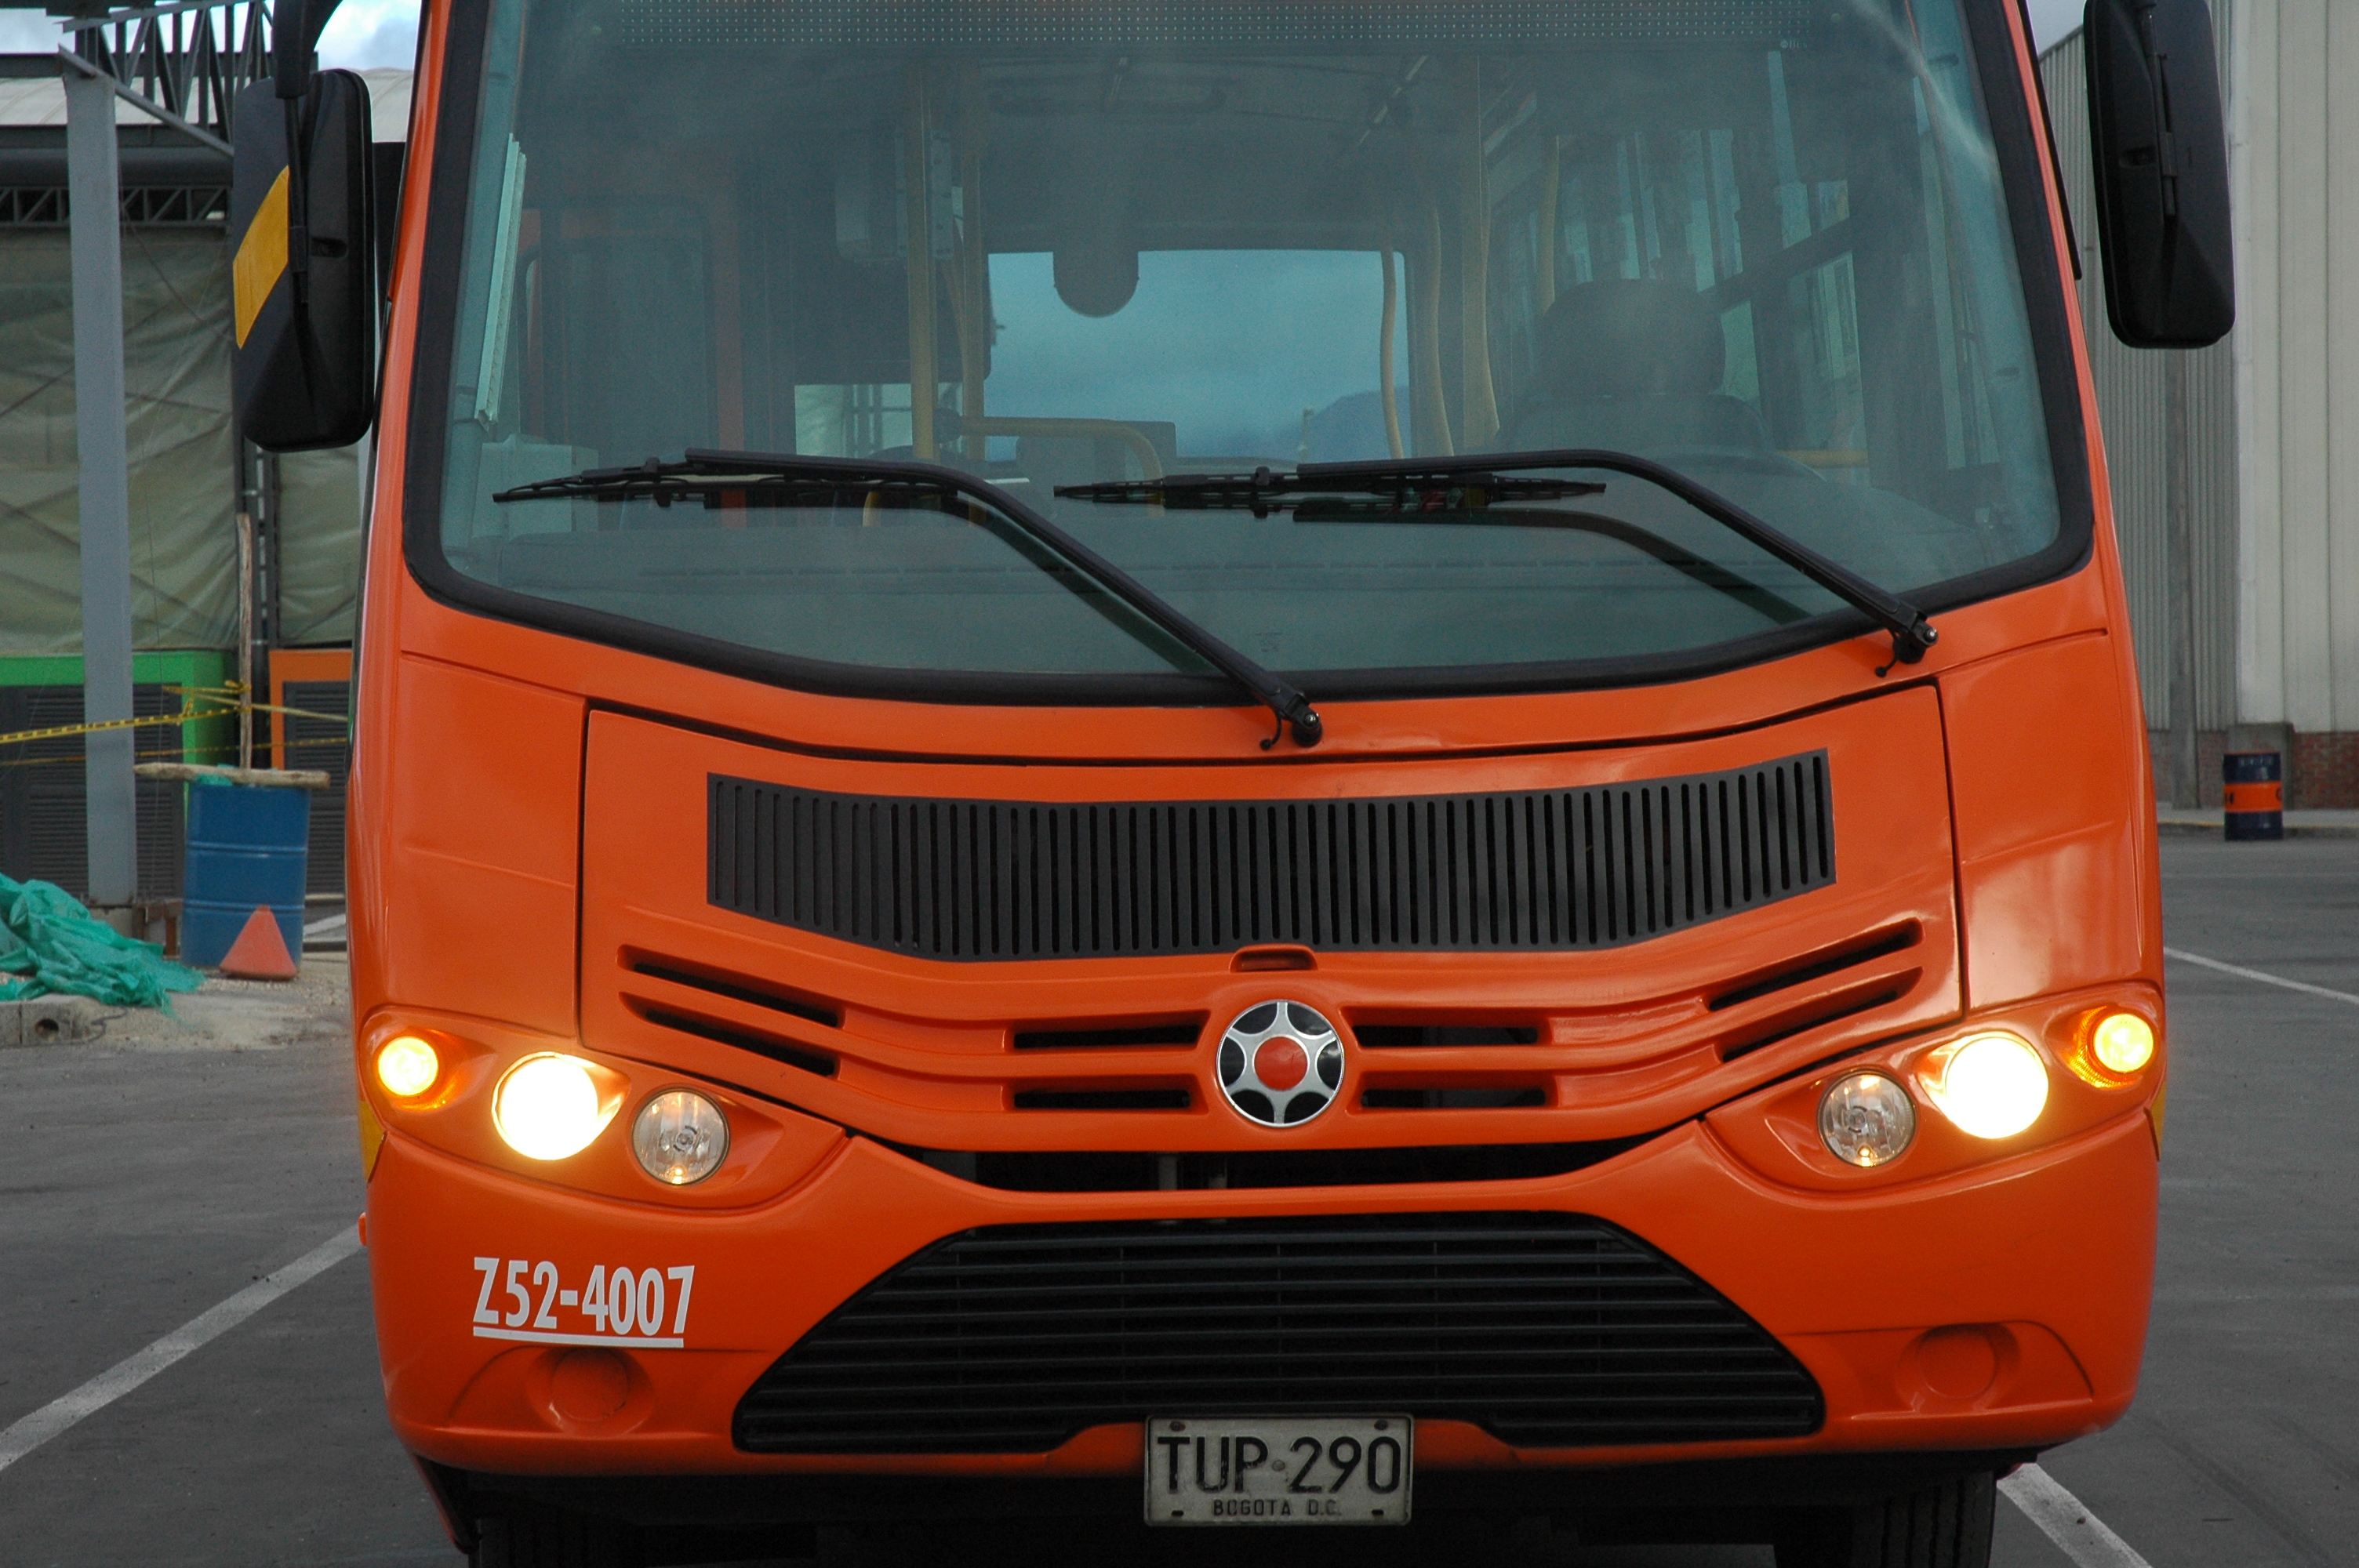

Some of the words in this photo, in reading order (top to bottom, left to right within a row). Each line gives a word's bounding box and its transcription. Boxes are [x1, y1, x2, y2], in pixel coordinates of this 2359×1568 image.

[473, 1256, 695, 1336] Z52-4007
[1157, 1436, 1269, 1494] TUP
[1289, 1436, 1401, 1494] 290
[1212, 1498, 1292, 1516] BOGOTA
